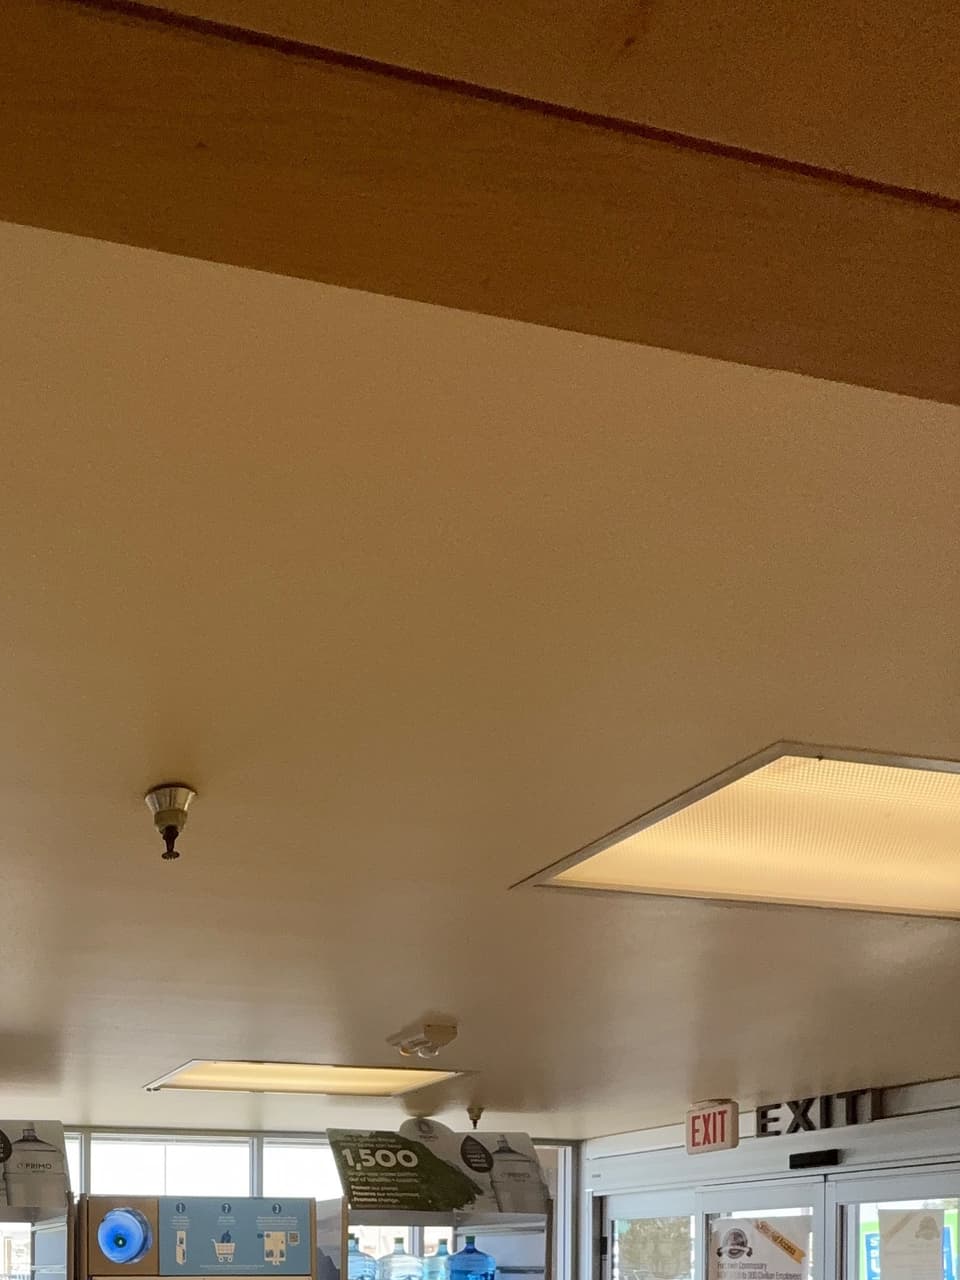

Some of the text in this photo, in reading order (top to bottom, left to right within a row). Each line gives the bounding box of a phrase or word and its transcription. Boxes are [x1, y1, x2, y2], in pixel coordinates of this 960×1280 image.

[692, 1110, 727, 1147] EXIT
[756, 1088, 872, 1138] EXIT
[341, 1148, 418, 1171] 1,500
